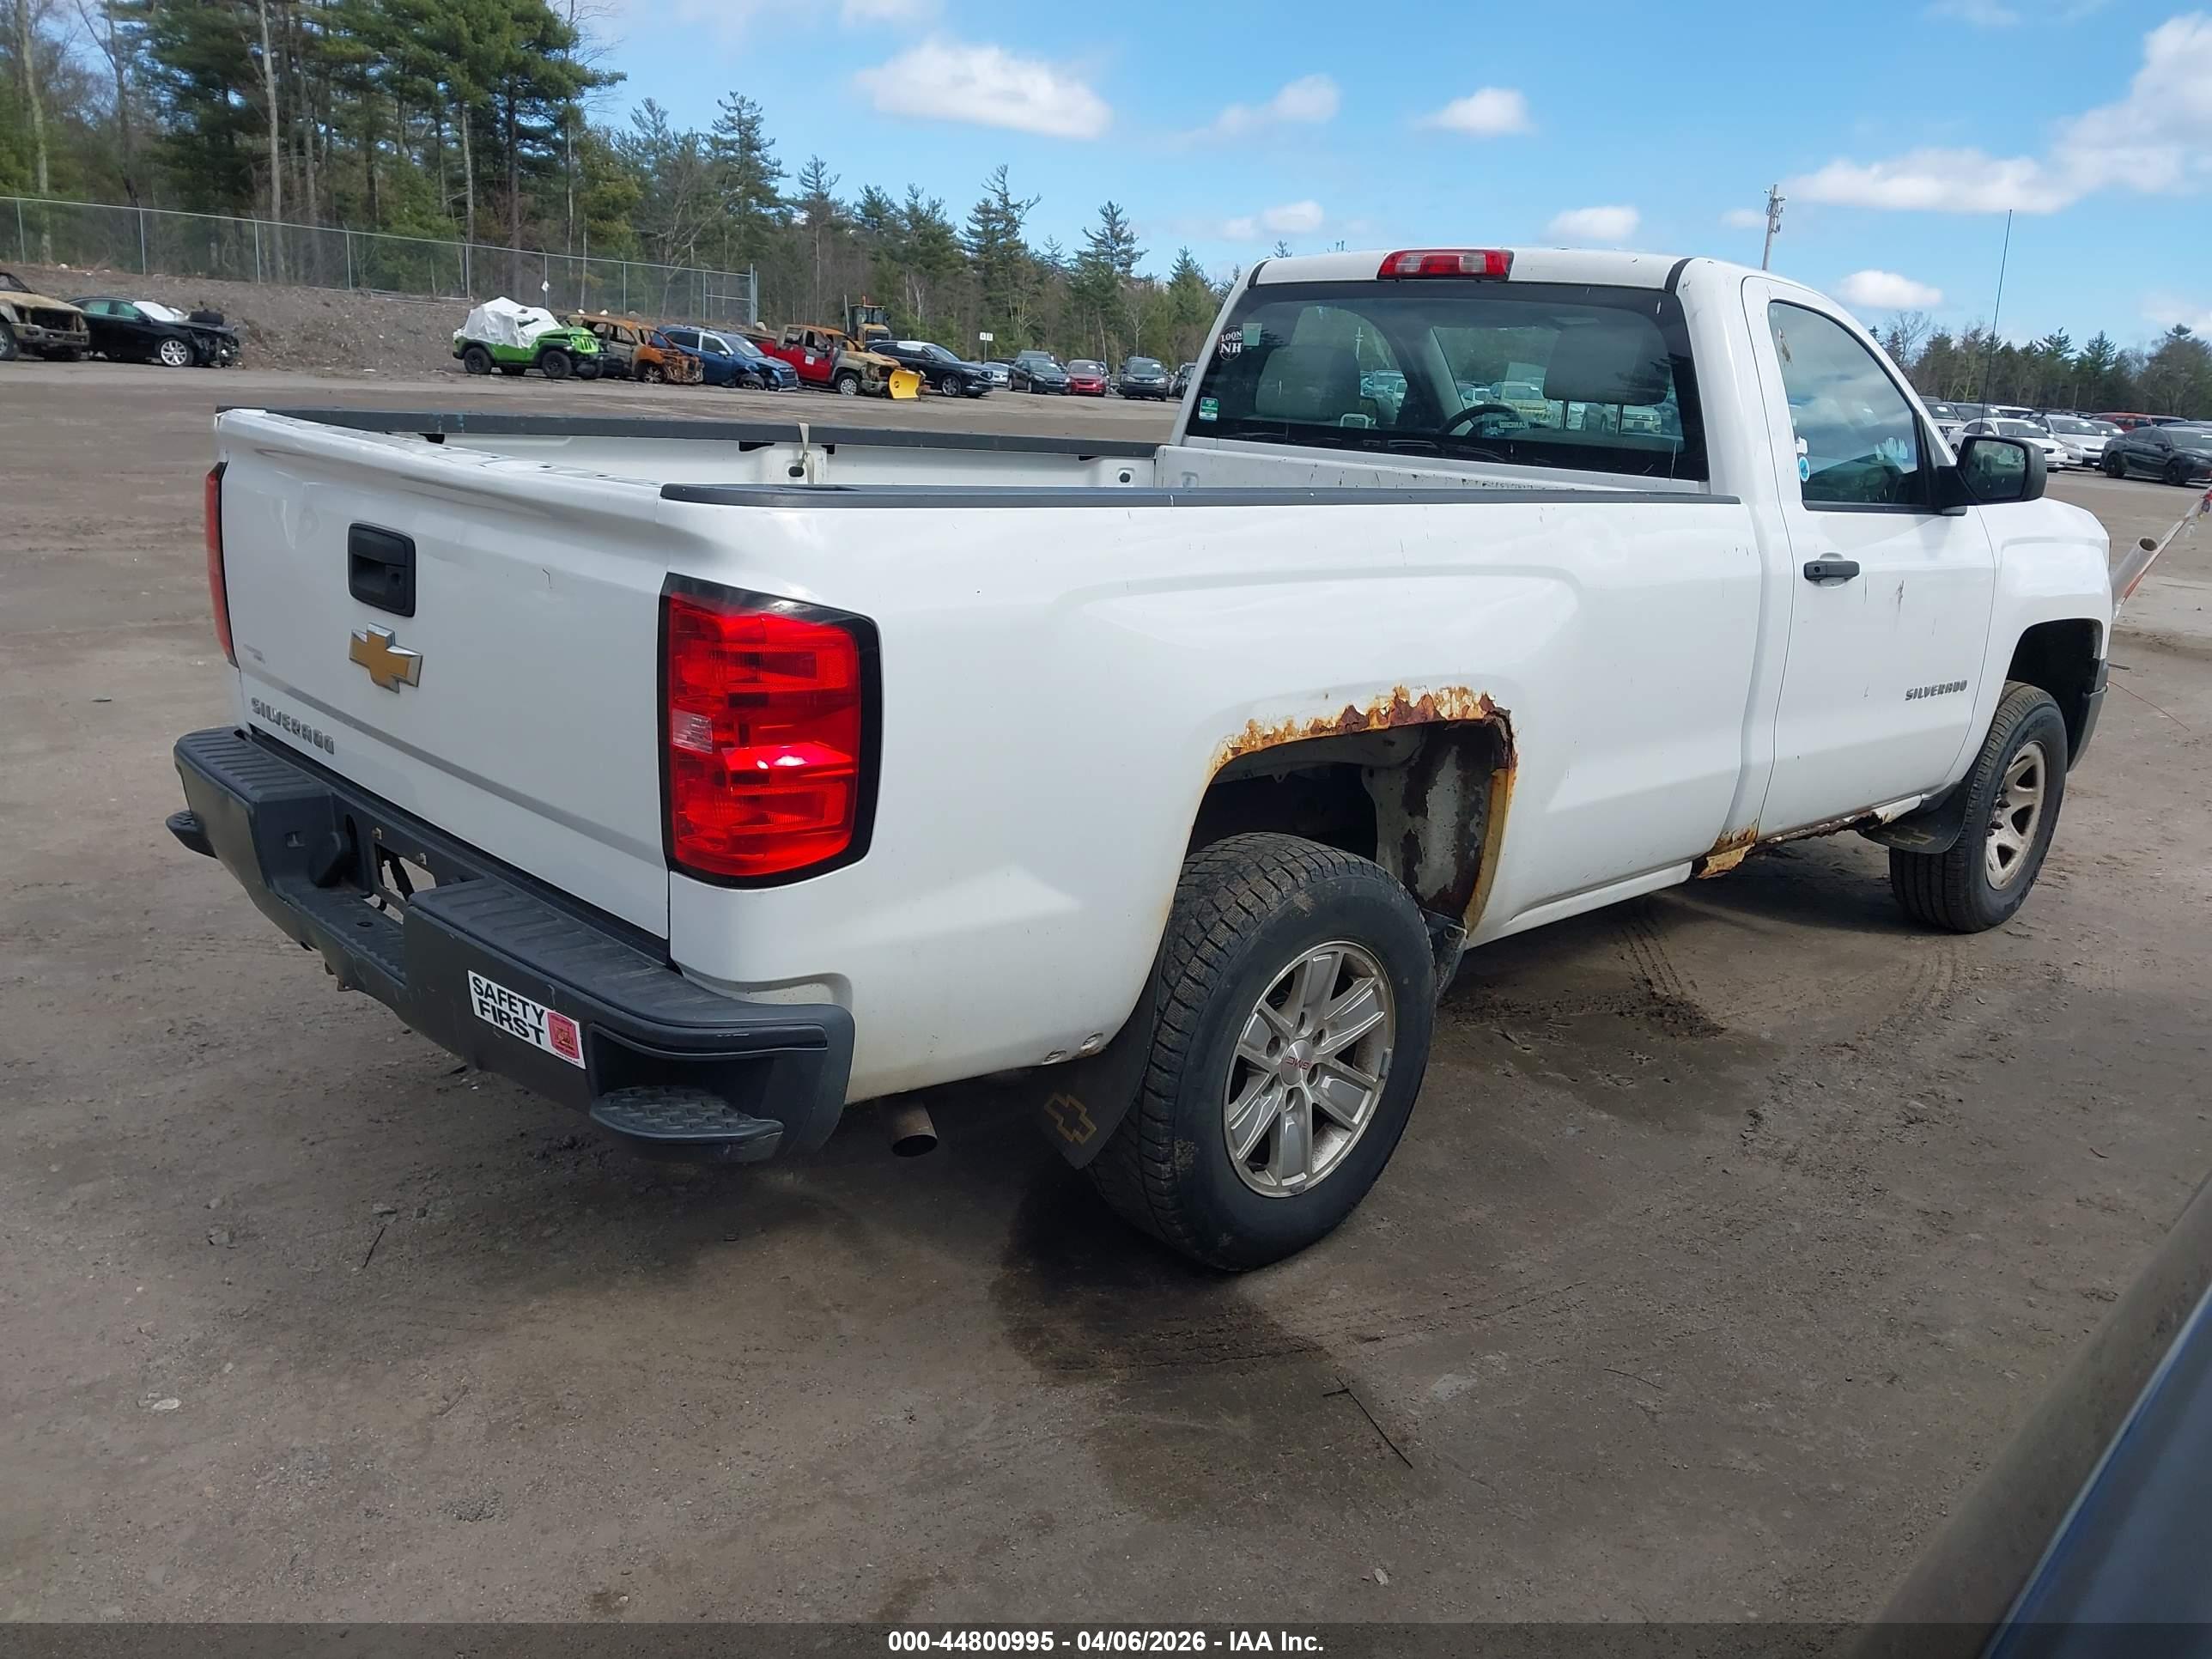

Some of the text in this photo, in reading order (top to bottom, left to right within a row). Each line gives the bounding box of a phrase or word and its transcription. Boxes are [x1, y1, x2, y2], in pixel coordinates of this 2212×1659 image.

[1220, 330, 1243, 342] LOON
[1219, 343, 1243, 353] NH
[1905, 679, 1967, 701] SILVERADO
[251, 697, 335, 755] SILVERADO
[472, 975, 544, 1026] SAFETY
[477, 998, 544, 1045] FIRST
[1285, 1055, 1310, 1071] GMC
